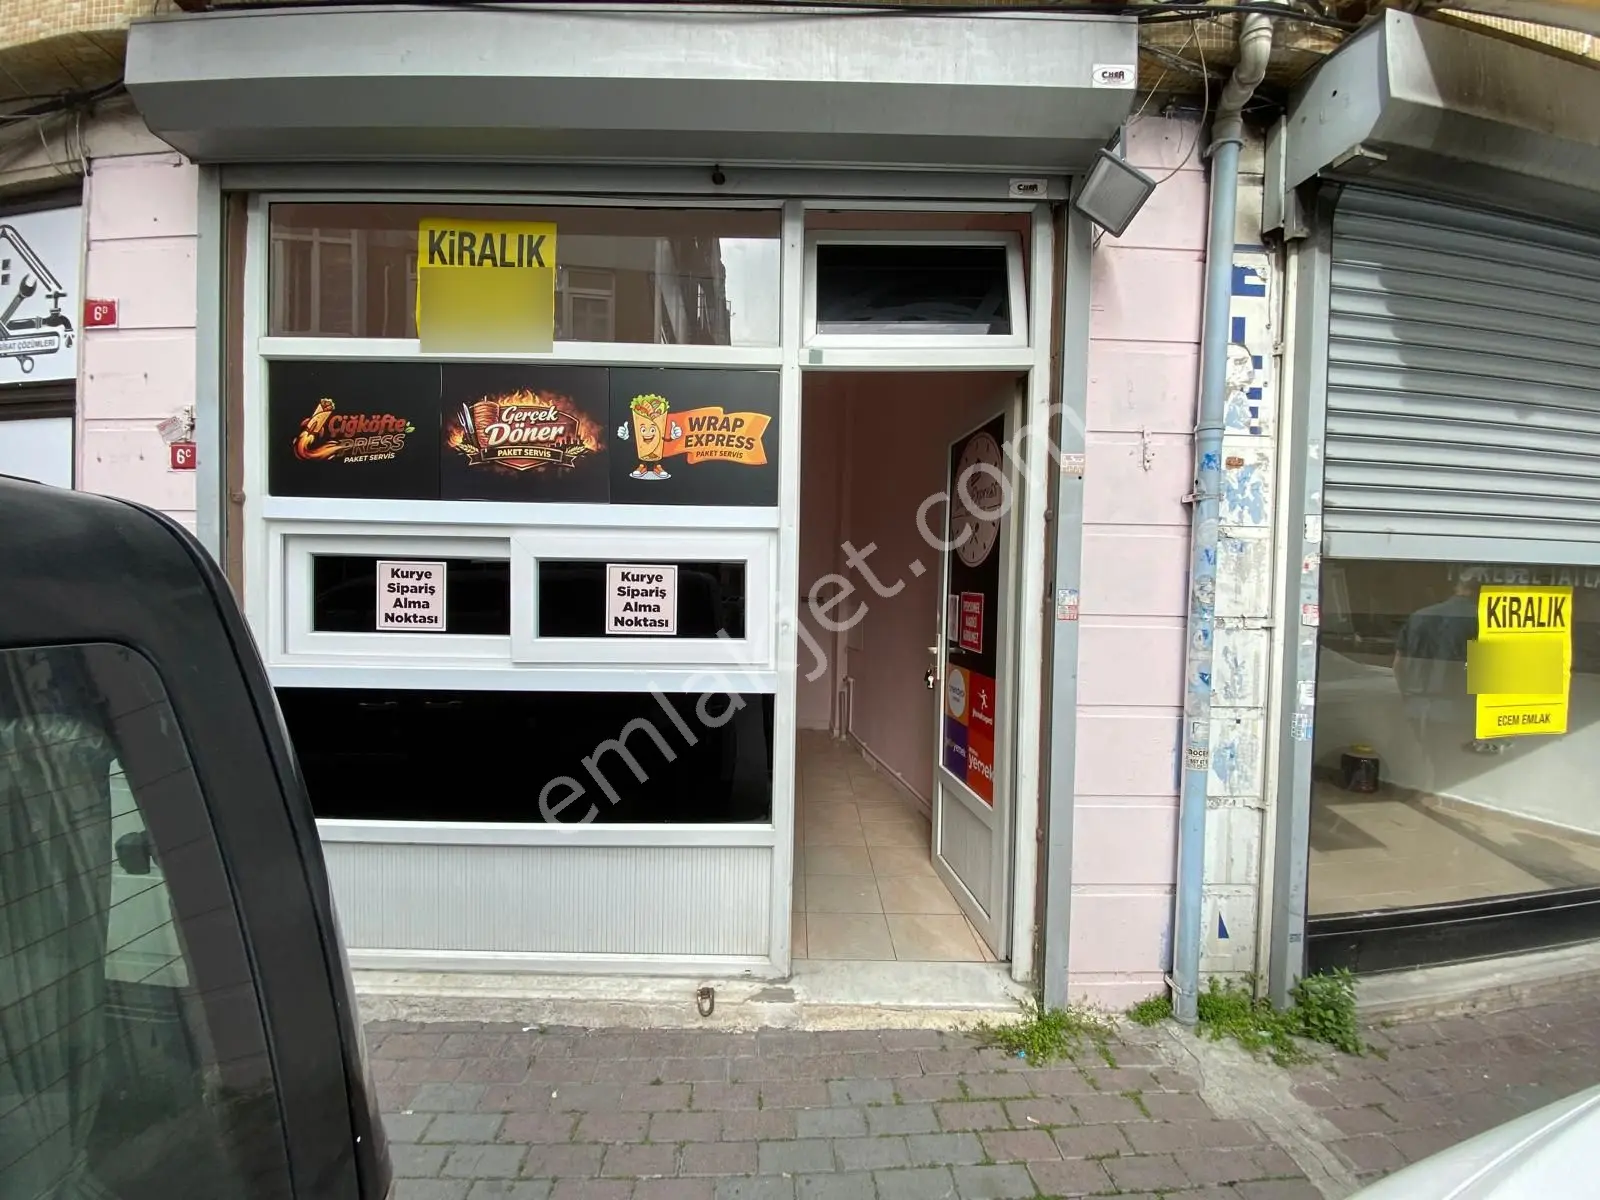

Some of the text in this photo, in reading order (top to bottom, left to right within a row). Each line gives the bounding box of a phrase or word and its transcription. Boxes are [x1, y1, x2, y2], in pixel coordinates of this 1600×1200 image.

[501, 406, 558, 424] Gerçek
[688, 416, 745, 432] WRAP
[485, 423, 565, 446] Döner
[684, 433, 756, 450] EXPRESS
[343, 455, 368, 463] PAKET
[497, 448, 523, 457] PAKET
[695, 450, 718, 458] PAKET
[390, 567, 433, 581] Kurye
[621, 571, 664, 585] Kurye
[387, 582, 436, 596] Sipariş
[617, 586, 667, 600] Sipariş
[392, 597, 430, 609] Alma
[622, 601, 661, 613] Alma
[384, 612, 438, 624] Noktası
[613, 616, 669, 628] Noktası
[1497, 713, 1551, 727] ECEM EMLAK
